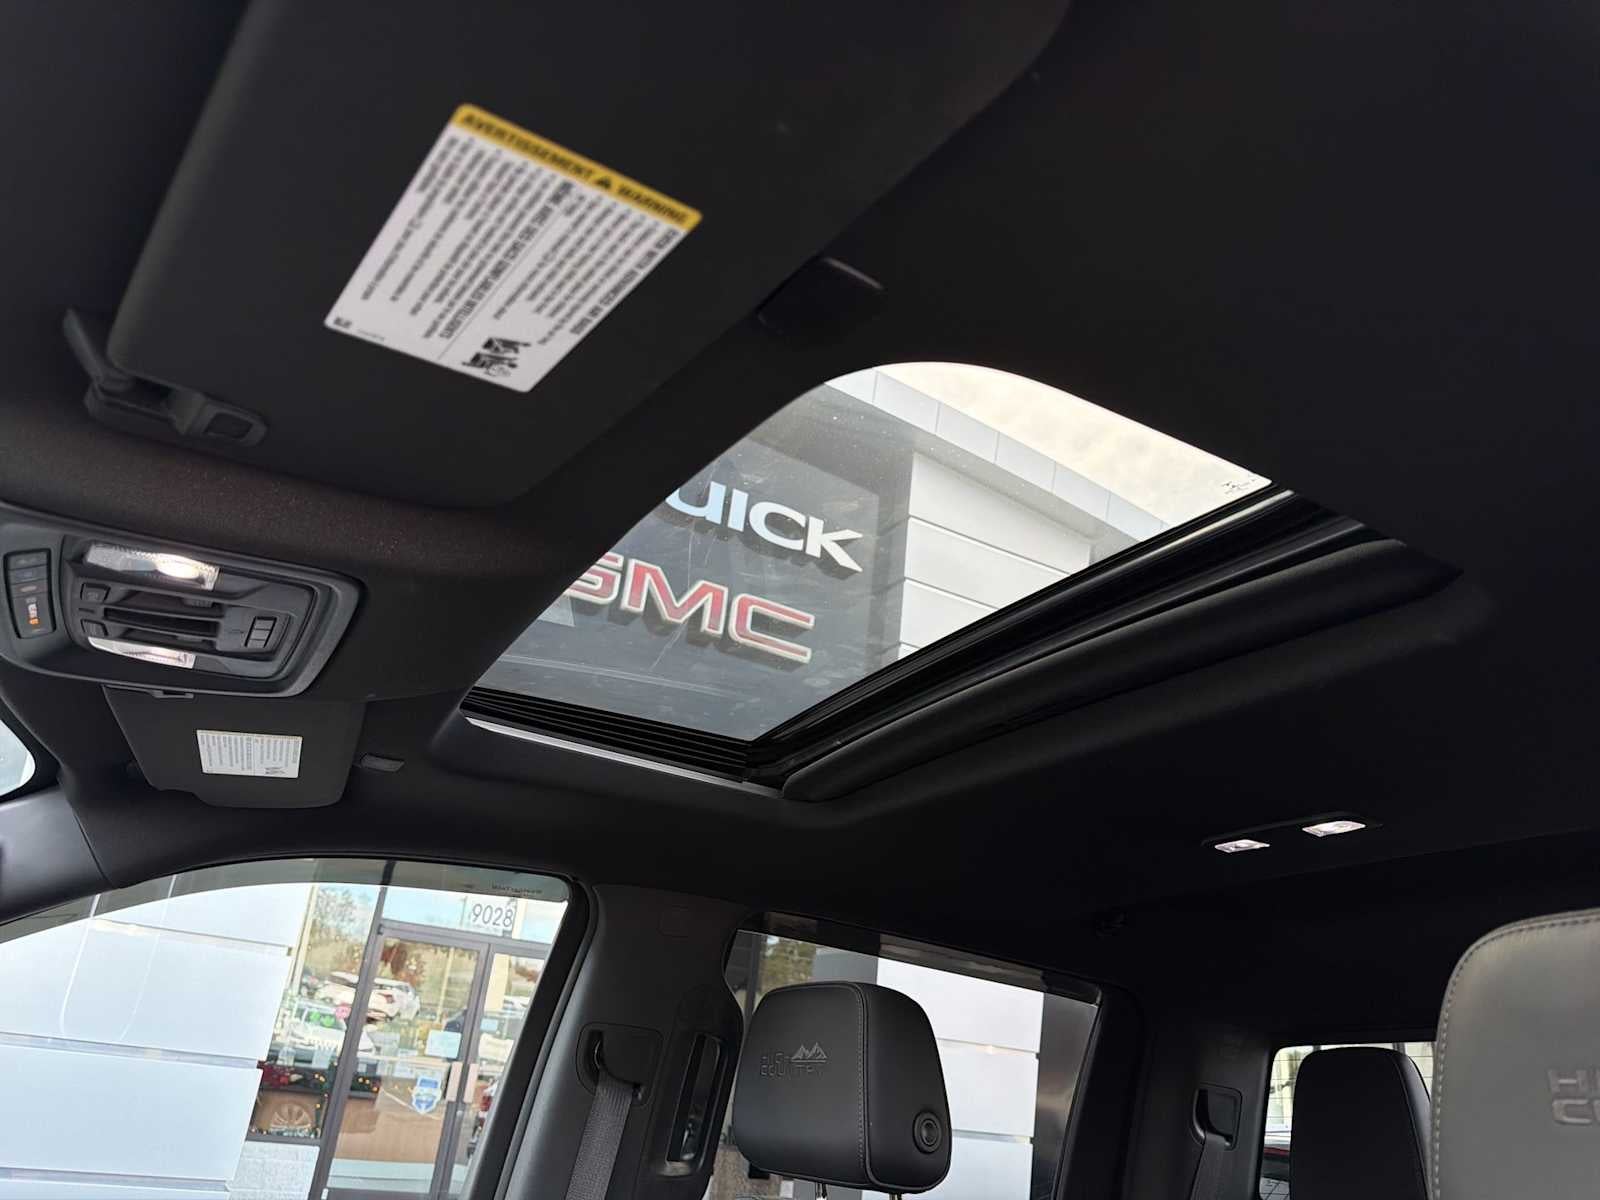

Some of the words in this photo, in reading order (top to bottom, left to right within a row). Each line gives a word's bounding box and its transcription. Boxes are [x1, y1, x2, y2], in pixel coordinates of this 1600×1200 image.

[617, 185, 689, 224] WARNING
[568, 552, 816, 664] GMC
[472, 903, 514, 928] 9028
